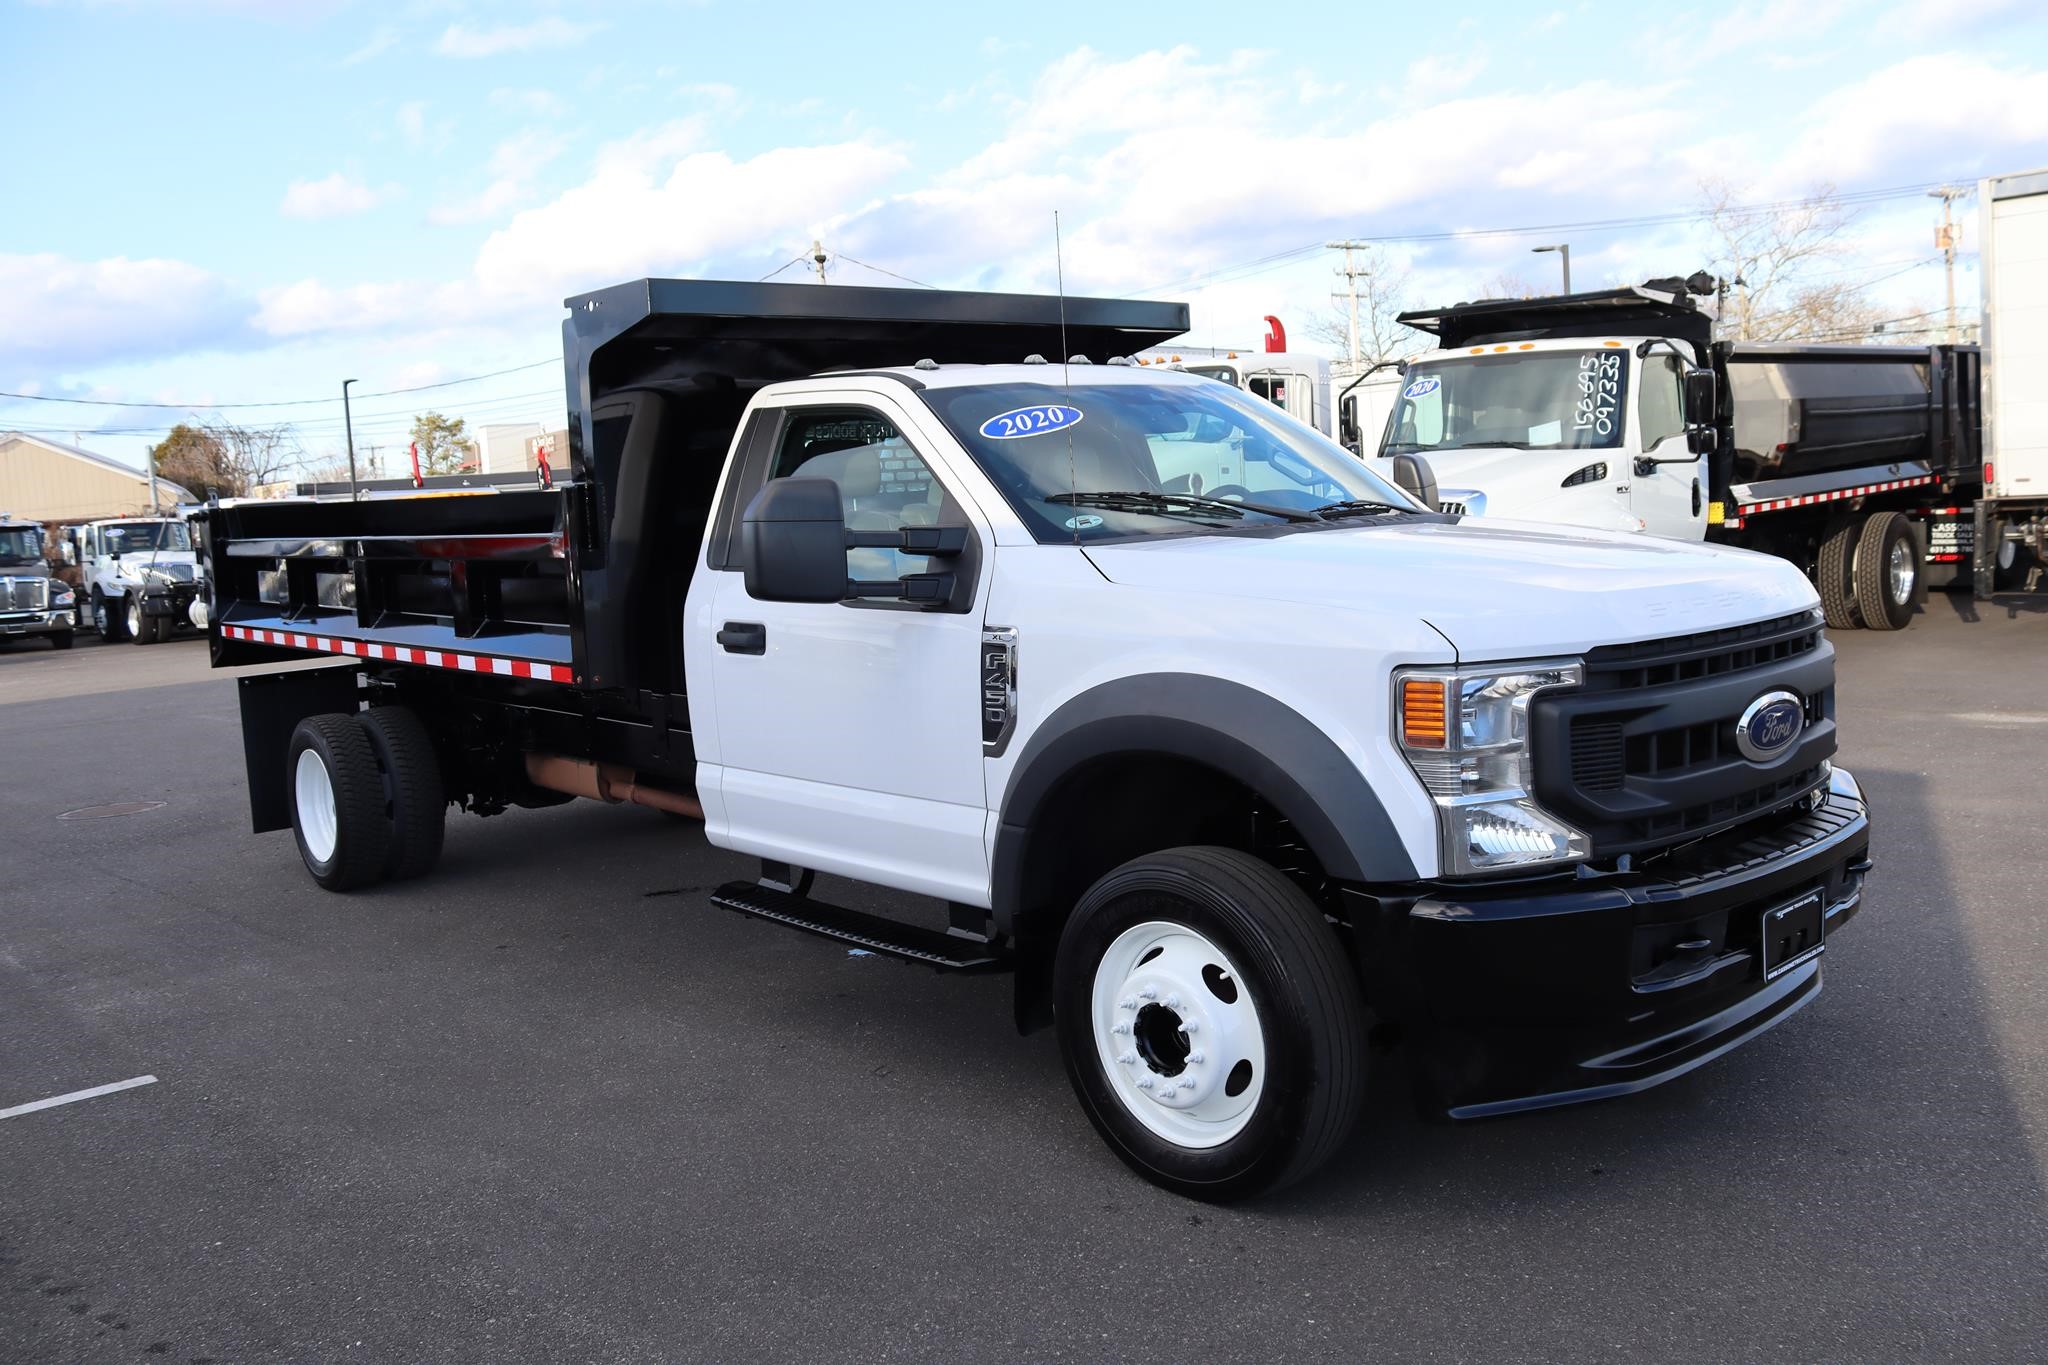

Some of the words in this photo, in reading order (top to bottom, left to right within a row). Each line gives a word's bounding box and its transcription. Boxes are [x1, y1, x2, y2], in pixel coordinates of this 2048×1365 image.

[1596, 353, 1620, 435] 097335
[998, 407, 1064, 436] 2020
[985, 653, 1006, 722] F450
[1762, 711, 1792, 743] Ford
